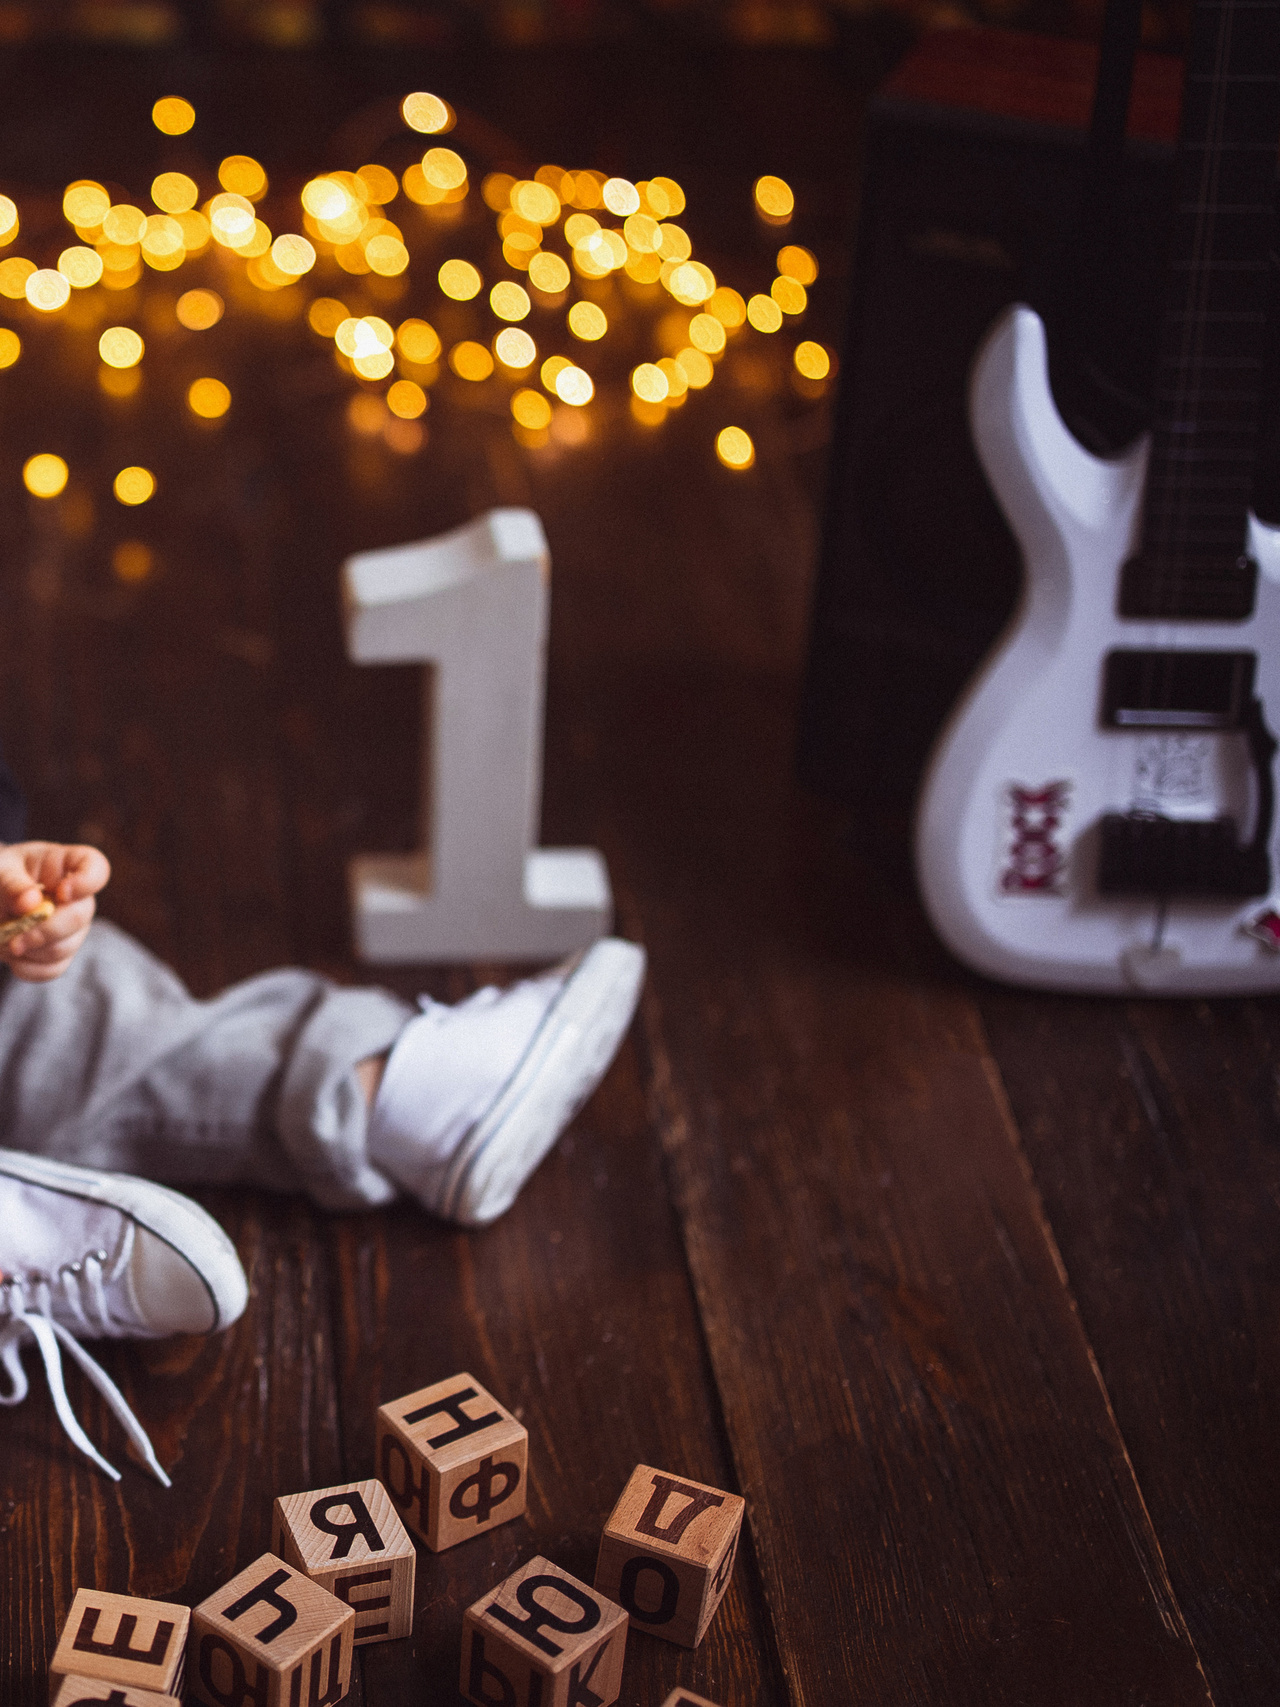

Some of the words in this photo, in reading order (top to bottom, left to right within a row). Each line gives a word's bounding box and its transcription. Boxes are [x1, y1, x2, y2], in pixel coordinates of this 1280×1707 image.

[402, 1388, 503, 1450] Н
[381, 1434, 431, 1536] Ю
[449, 1456, 520, 1524] Ф
[634, 1475, 725, 1544] Д
[310, 1491, 385, 1559] Я
[485, 1575, 601, 1658] Ю
[620, 1556, 680, 1625] О
